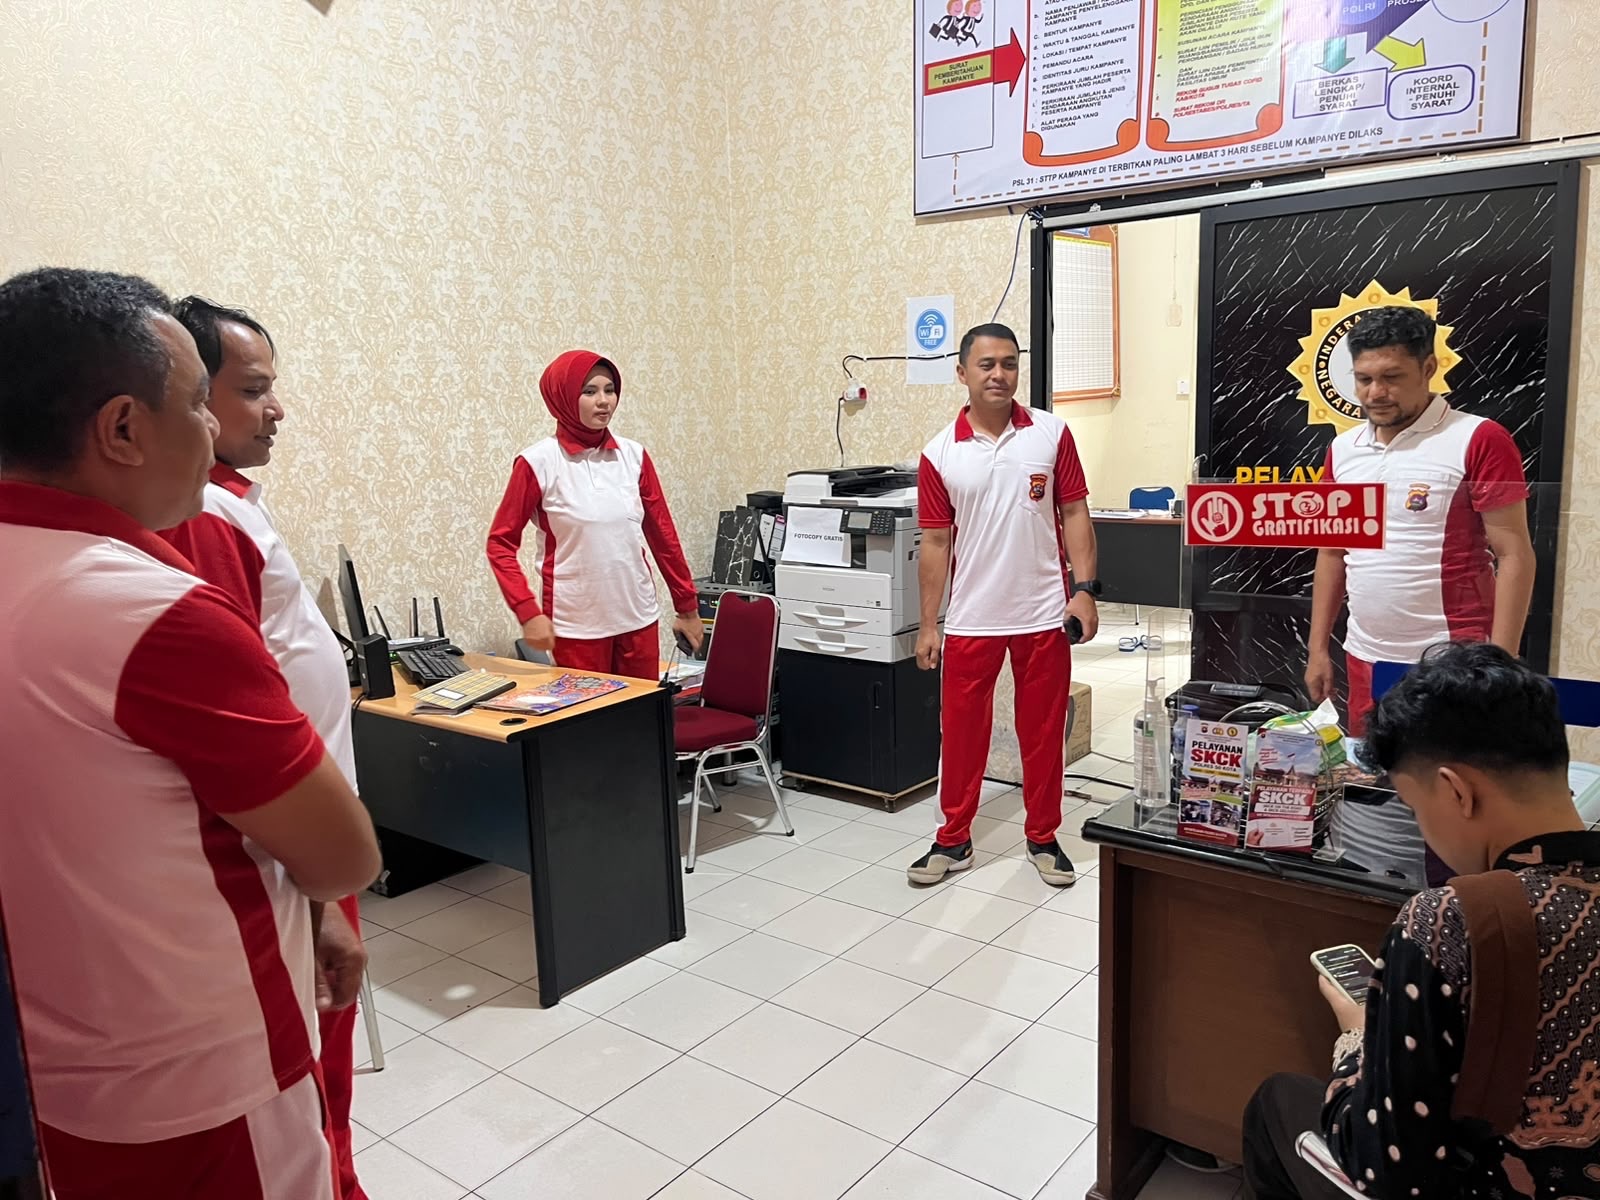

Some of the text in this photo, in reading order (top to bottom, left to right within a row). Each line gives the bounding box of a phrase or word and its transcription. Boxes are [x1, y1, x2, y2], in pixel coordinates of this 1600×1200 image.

[1044, 10, 1078, 21] KAMPANYE
[1045, 8, 1062, 16] NAMA
[1342, 3, 1376, 14] POLRI
[1044, 15, 1077, 27] KAMPANYE
[1043, 38, 1064, 48] WAKTU
[1071, 33, 1100, 43] TANGGAL
[1101, 24, 1135, 36] KAMPANYE
[1044, 28, 1068, 38] BENTUK
[1069, 20, 1102, 32] KAMPANYE
[1042, 49, 1065, 59] LOKASI
[1068, 44, 1092, 54] TEMPAT
[1093, 36, 1127, 48] KAMPANYE
[949, 61, 969, 71] SURAT
[1042, 58, 1072, 69] PEMANDU
[1072, 54, 1094, 63] ACARA
[934, 64, 984, 80] PEMBERITAHUAN
[1042, 69, 1072, 80] IDENTITAS
[1073, 66, 1090, 74] JURU
[1090, 59, 1124, 71] KAMPANYE
[942, 73, 975, 85] KAMPANYE
[1042, 79, 1076, 90] PERKIRAAN
[1076, 75, 1101, 84] JUMLAH
[1102, 68, 1131, 78] PESERTA
[1221, 81, 1242, 89] TUGAS
[1318, 76, 1359, 89] BERKAS
[1413, 74, 1453, 86] KOORD
[1041, 77, 1112, 96] KAMPANYE YANG HADIR
[1314, 83, 1366, 97] LENGKAP/
[1406, 82, 1460, 95] INTERNAL
[1041, 95, 1076, 106] PERKIRAAN
[1076, 90, 1101, 100] JUMLAH
[1108, 85, 1126, 94] JENIS
[1041, 94, 1113, 111] KENDARAAN ANGKUTAN
[1319, 93, 1357, 104] PENUHI
[1415, 90, 1456, 103] PENUHI
[1041, 101, 1102, 116] PESERTA KAMPANYE
[1319, 99, 1358, 112] SYARAT
[1411, 98, 1453, 110] SYARAT
[1040, 119, 1056, 127] ALAT
[1057, 115, 1082, 124] PERAGA
[1082, 111, 1099, 119] YANG
[1040, 121, 1076, 132] DIGUNAKAN
[1012, 178, 1025, 187] PSL
[1026, 177, 1035, 185] 31
[1039, 173, 1058, 183] STTP
[1058, 167, 1098, 180] KAMPANYE
[1098, 166, 1107, 174] DI
[1108, 160, 1151, 173] TERBITKAN
[1152, 154, 1183, 166] PALING
[1185, 149, 1219, 163] LAMBAT
[1220, 149, 1226, 157] 3
[1227, 145, 1249, 156] HARI
[1250, 140, 1293, 154] SEBELUM
[1295, 132, 1346, 147] KAMPANYE
[1348, 127, 1383, 139] DILAKS
[920, 328, 941, 337] Wi Fi
[1316, 368, 1361, 418] NEGARA
[1251, 490, 1352, 520] STOP
[1252, 517, 1360, 537] GRATIFIKASI
[793, 532, 823, 541] FOTOCOPY
[1191, 740, 1243, 754] PELAYANAN
[1190, 748, 1242, 768] SKCK
[1258, 790, 1307, 806] SKCK
